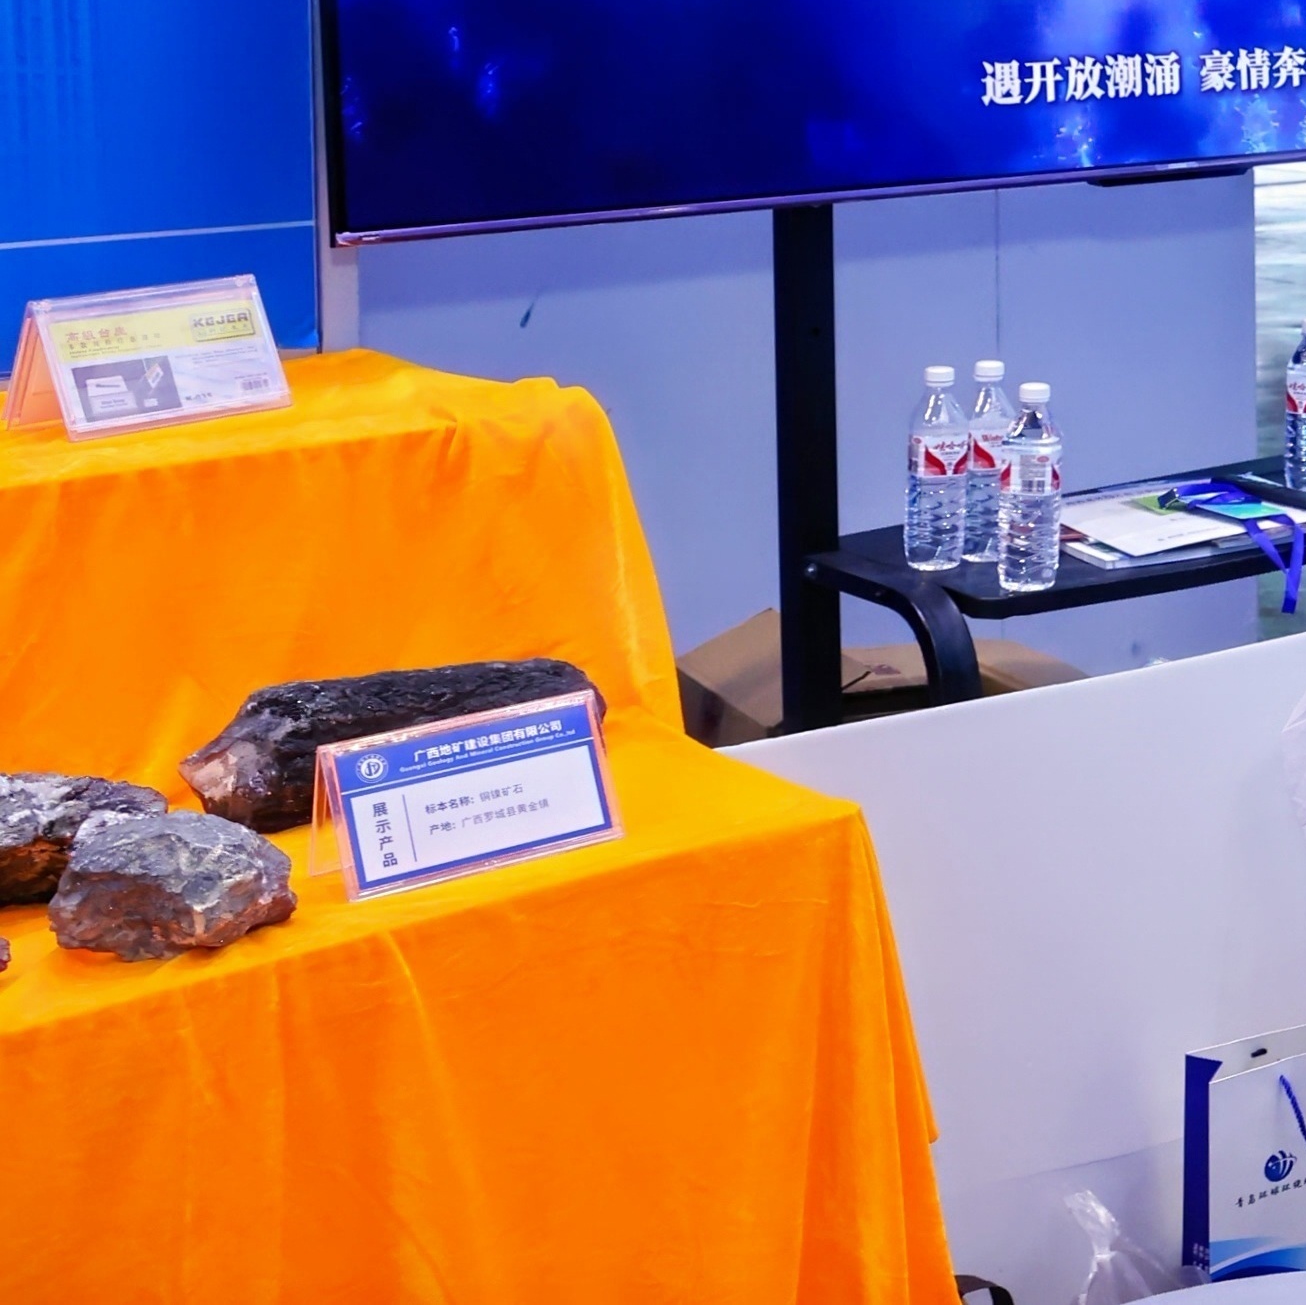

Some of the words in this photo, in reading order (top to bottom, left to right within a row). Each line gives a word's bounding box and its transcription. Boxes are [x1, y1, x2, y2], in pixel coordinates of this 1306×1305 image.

[981, 51, 1182, 106] 遇开放潮涌
[414, 720, 562, 762] 广西地矿建设集团有限公司
[372, 801, 398, 868] 展示产品
